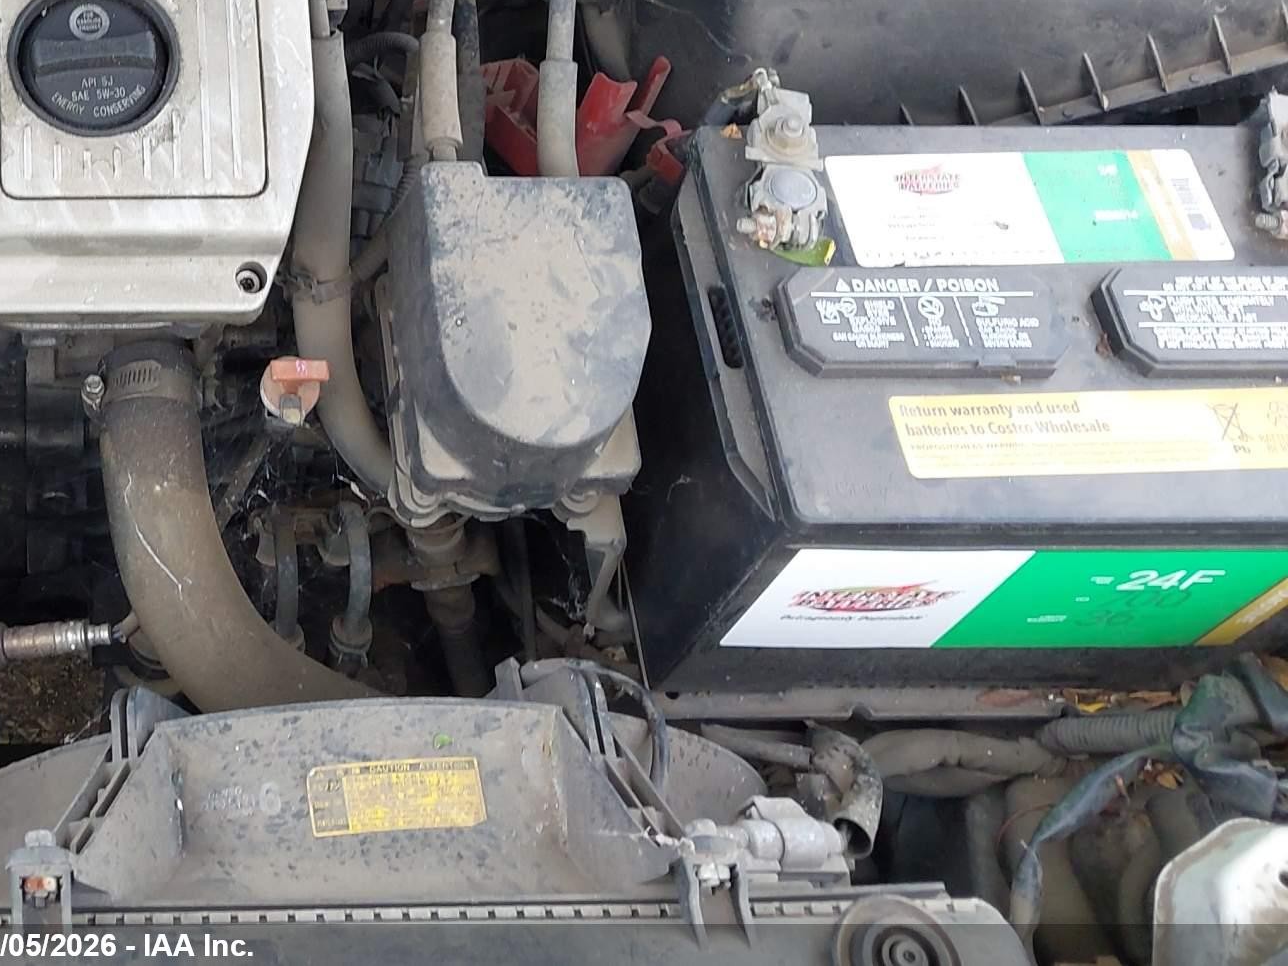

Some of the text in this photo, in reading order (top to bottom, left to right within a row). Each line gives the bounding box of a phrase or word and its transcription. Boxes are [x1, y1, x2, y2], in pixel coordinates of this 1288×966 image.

[81, 78, 97, 88] API
[51, 84, 146, 118] ENERGY CONSERVING
[71, 87, 126, 102] SAE 5W-30
[852, 278, 921, 292] DANGER
[936, 278, 1000, 292] POISON
[899, 400, 1081, 418] Return warranty and used
[905, 422, 967, 437] batteries
[970, 423, 985, 435] to
[1035, 419, 1111, 434] Wholesale
[1116, 569, 1226, 591] 24F
[369, 763, 411, 772] CAUTION
